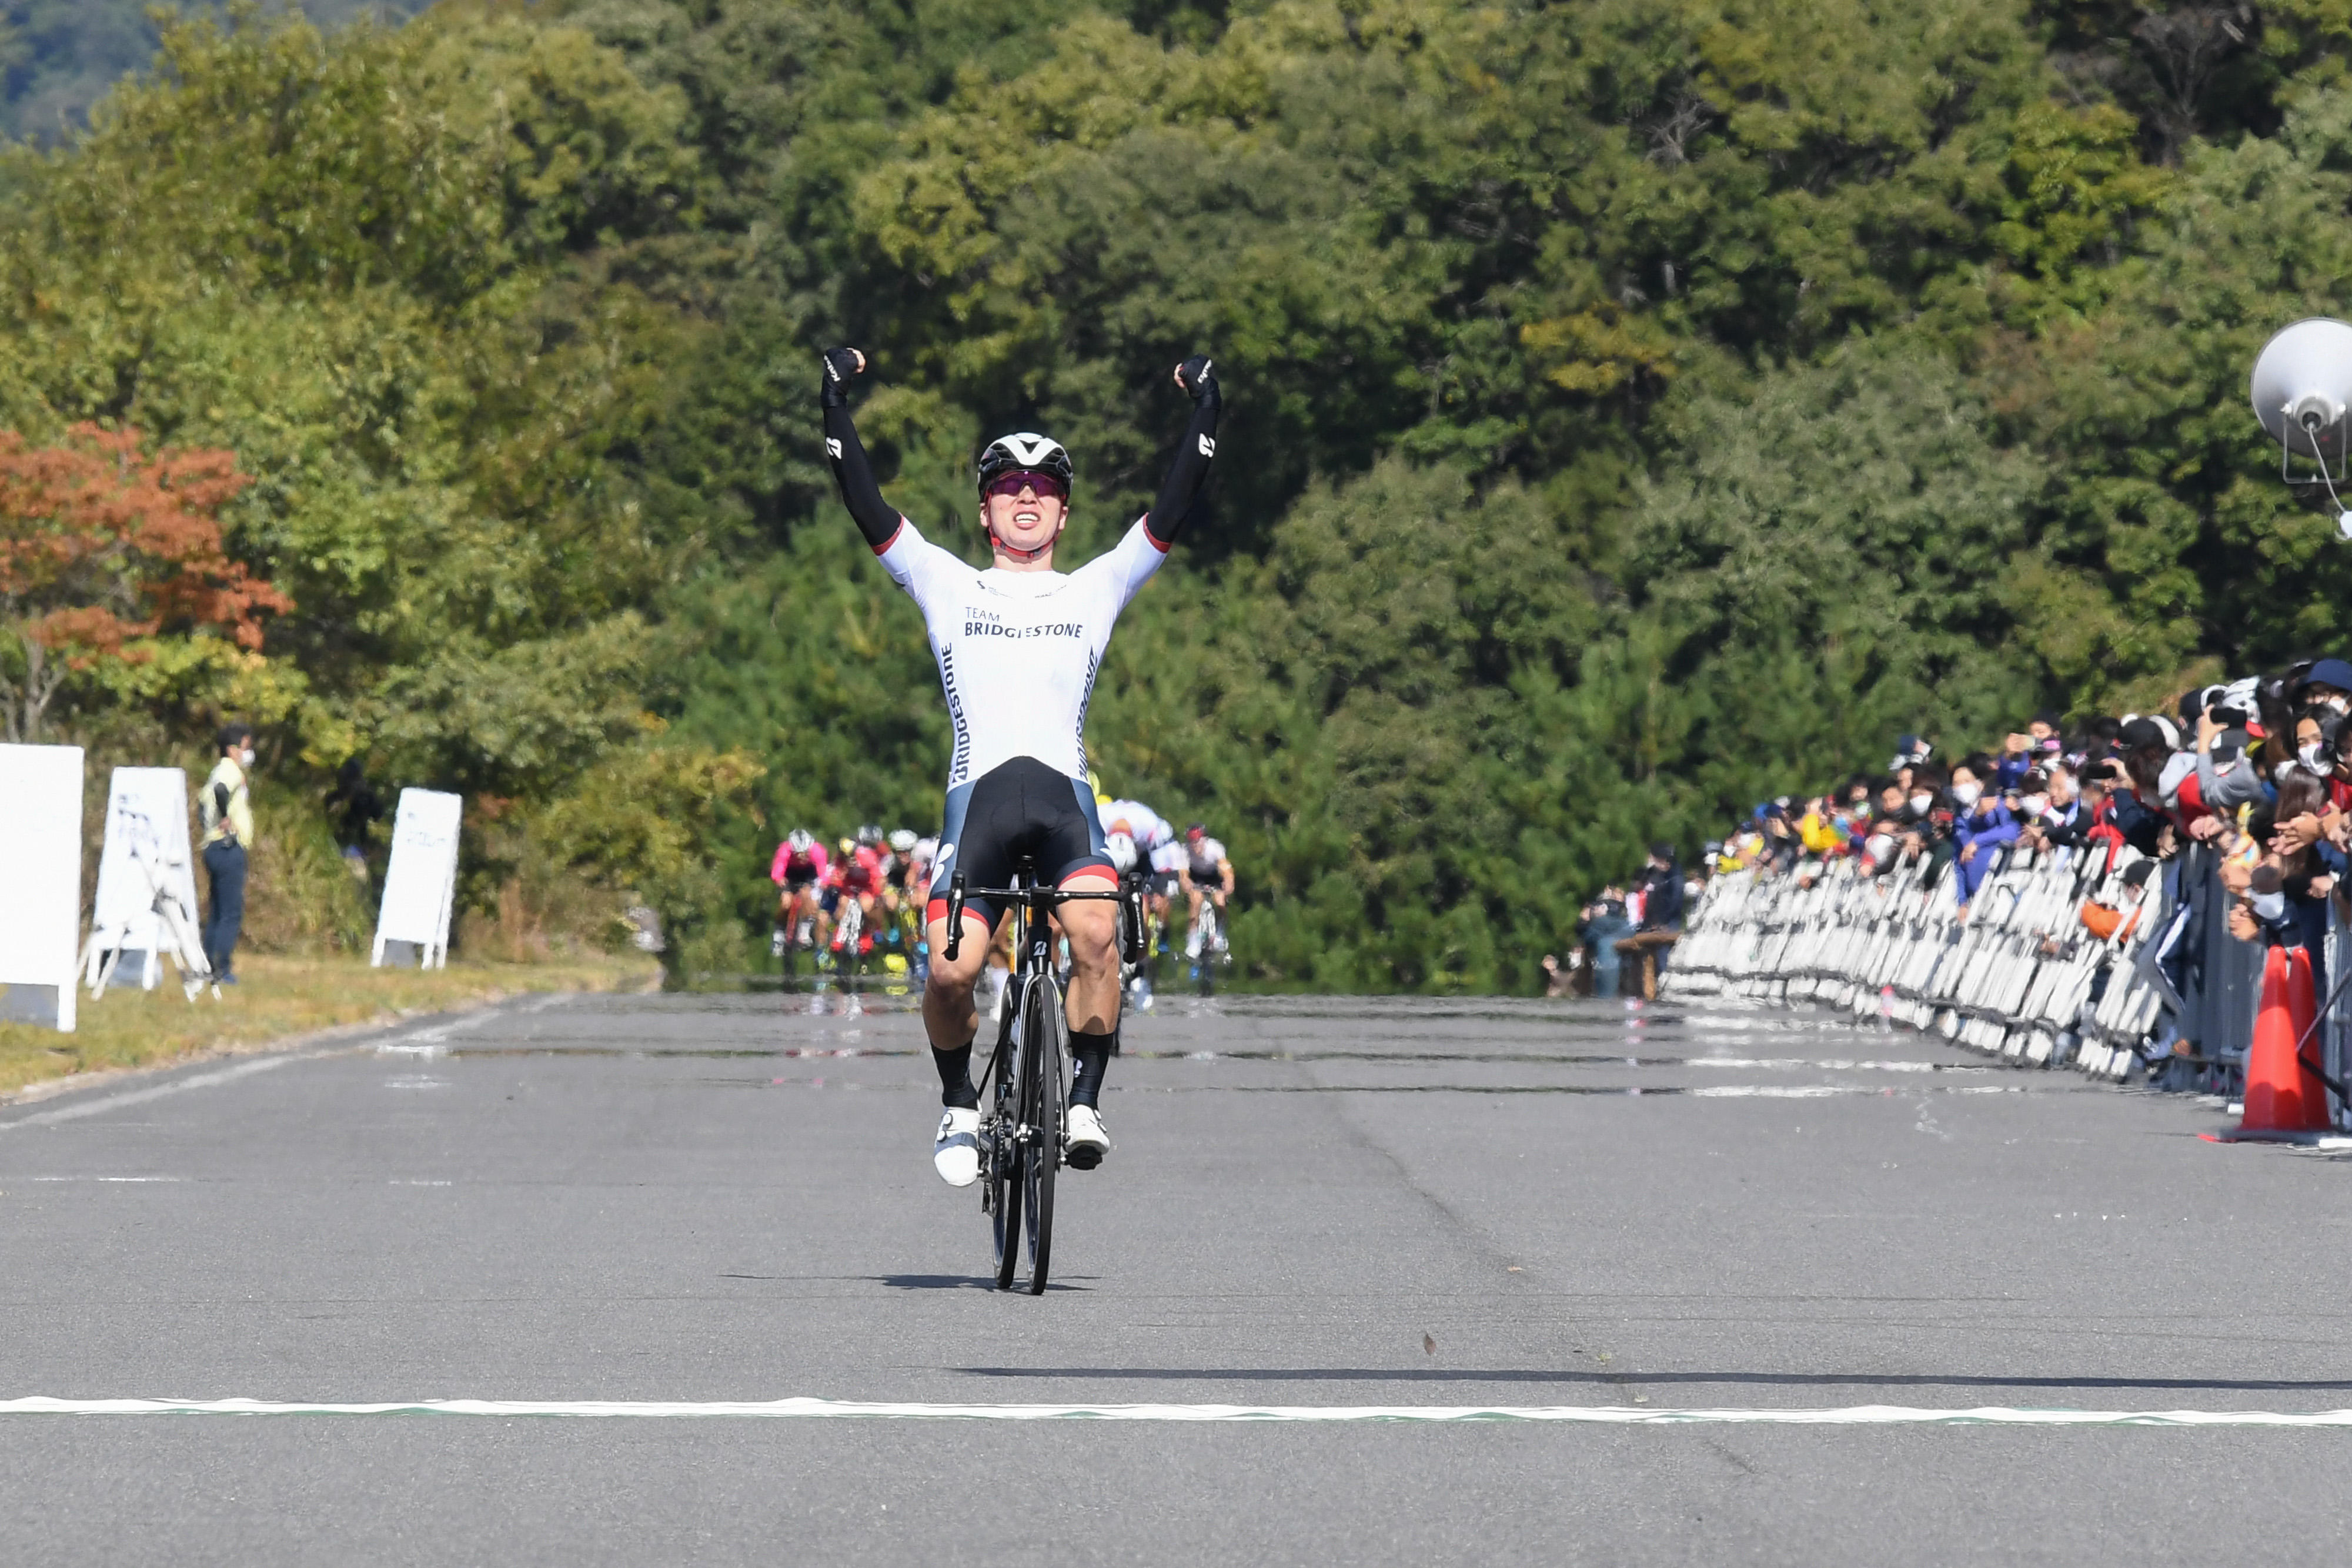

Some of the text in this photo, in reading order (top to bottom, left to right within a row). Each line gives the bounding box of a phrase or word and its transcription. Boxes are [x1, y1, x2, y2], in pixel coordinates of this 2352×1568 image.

[965, 607, 1000, 622] TEAM
[965, 621, 1083, 638] BRIDGESTONE
[941, 643, 971, 783] BRIDGESTONE
